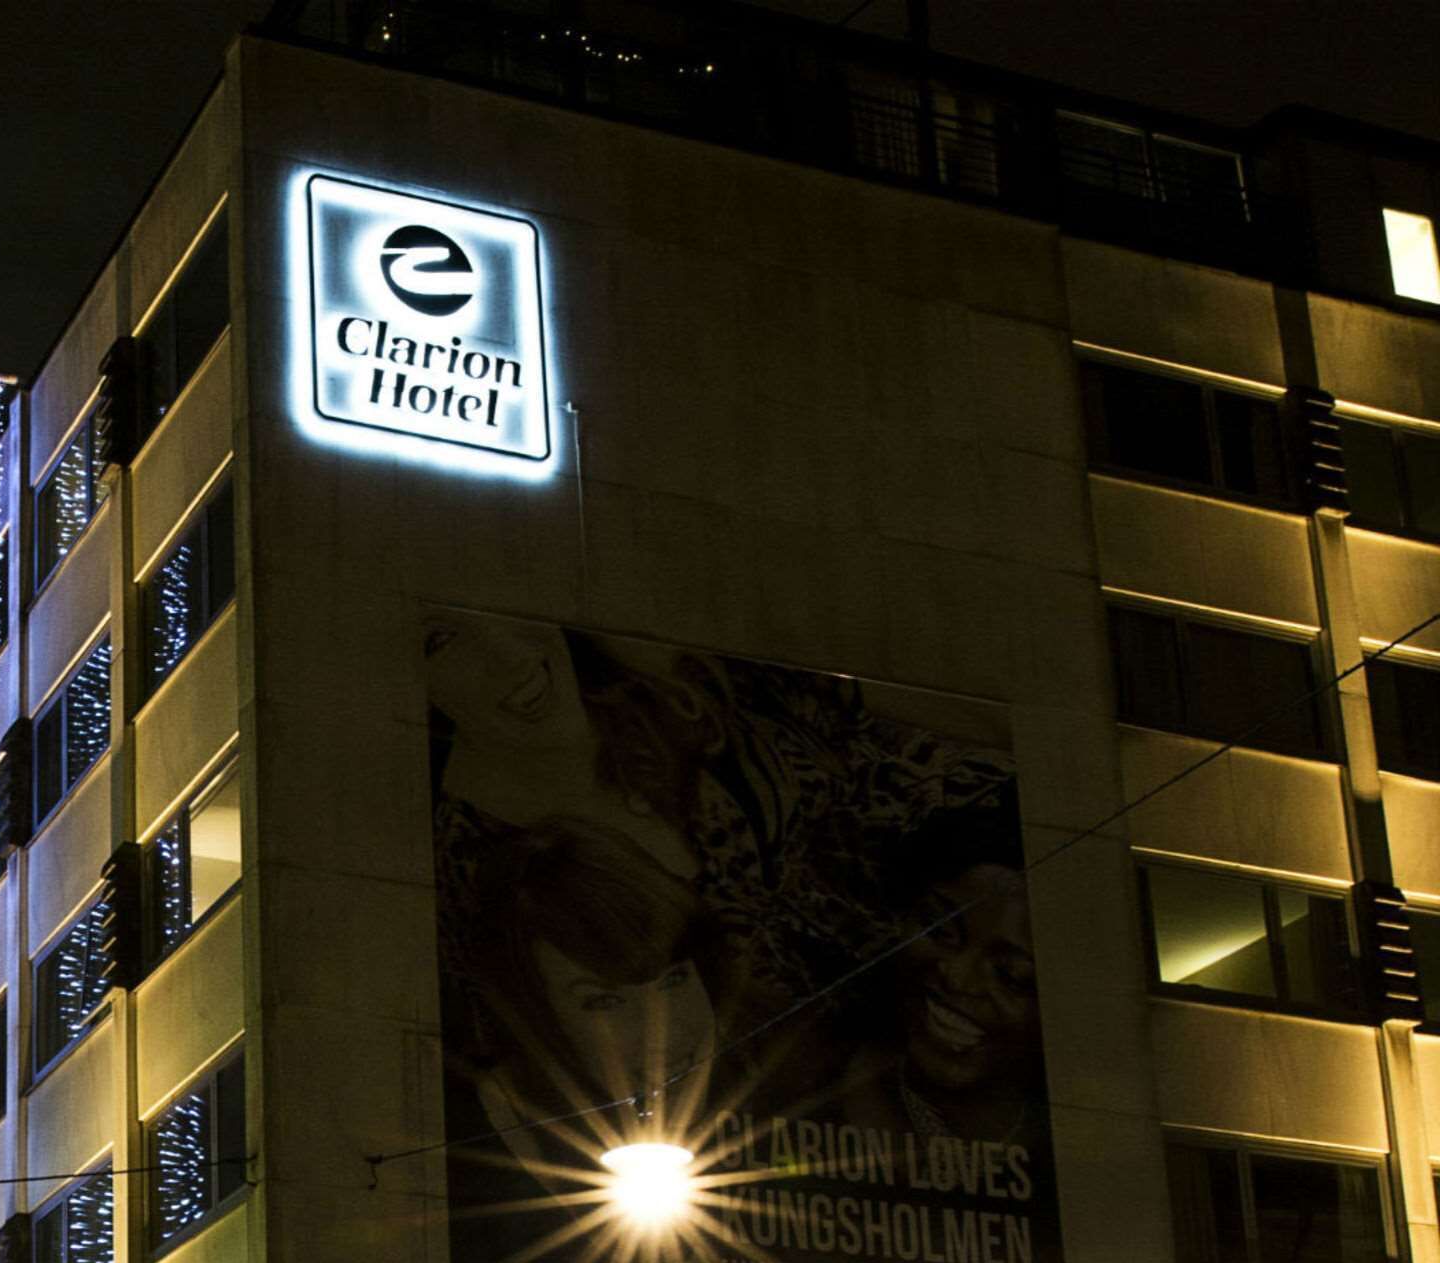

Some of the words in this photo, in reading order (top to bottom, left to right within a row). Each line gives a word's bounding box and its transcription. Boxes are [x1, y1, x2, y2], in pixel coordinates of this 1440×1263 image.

[336, 316, 523, 388] Clarion
[368, 368, 498, 428] Hotel
[715, 1109, 895, 1186] CLARION
[907, 1132, 1033, 1201] LOVES
